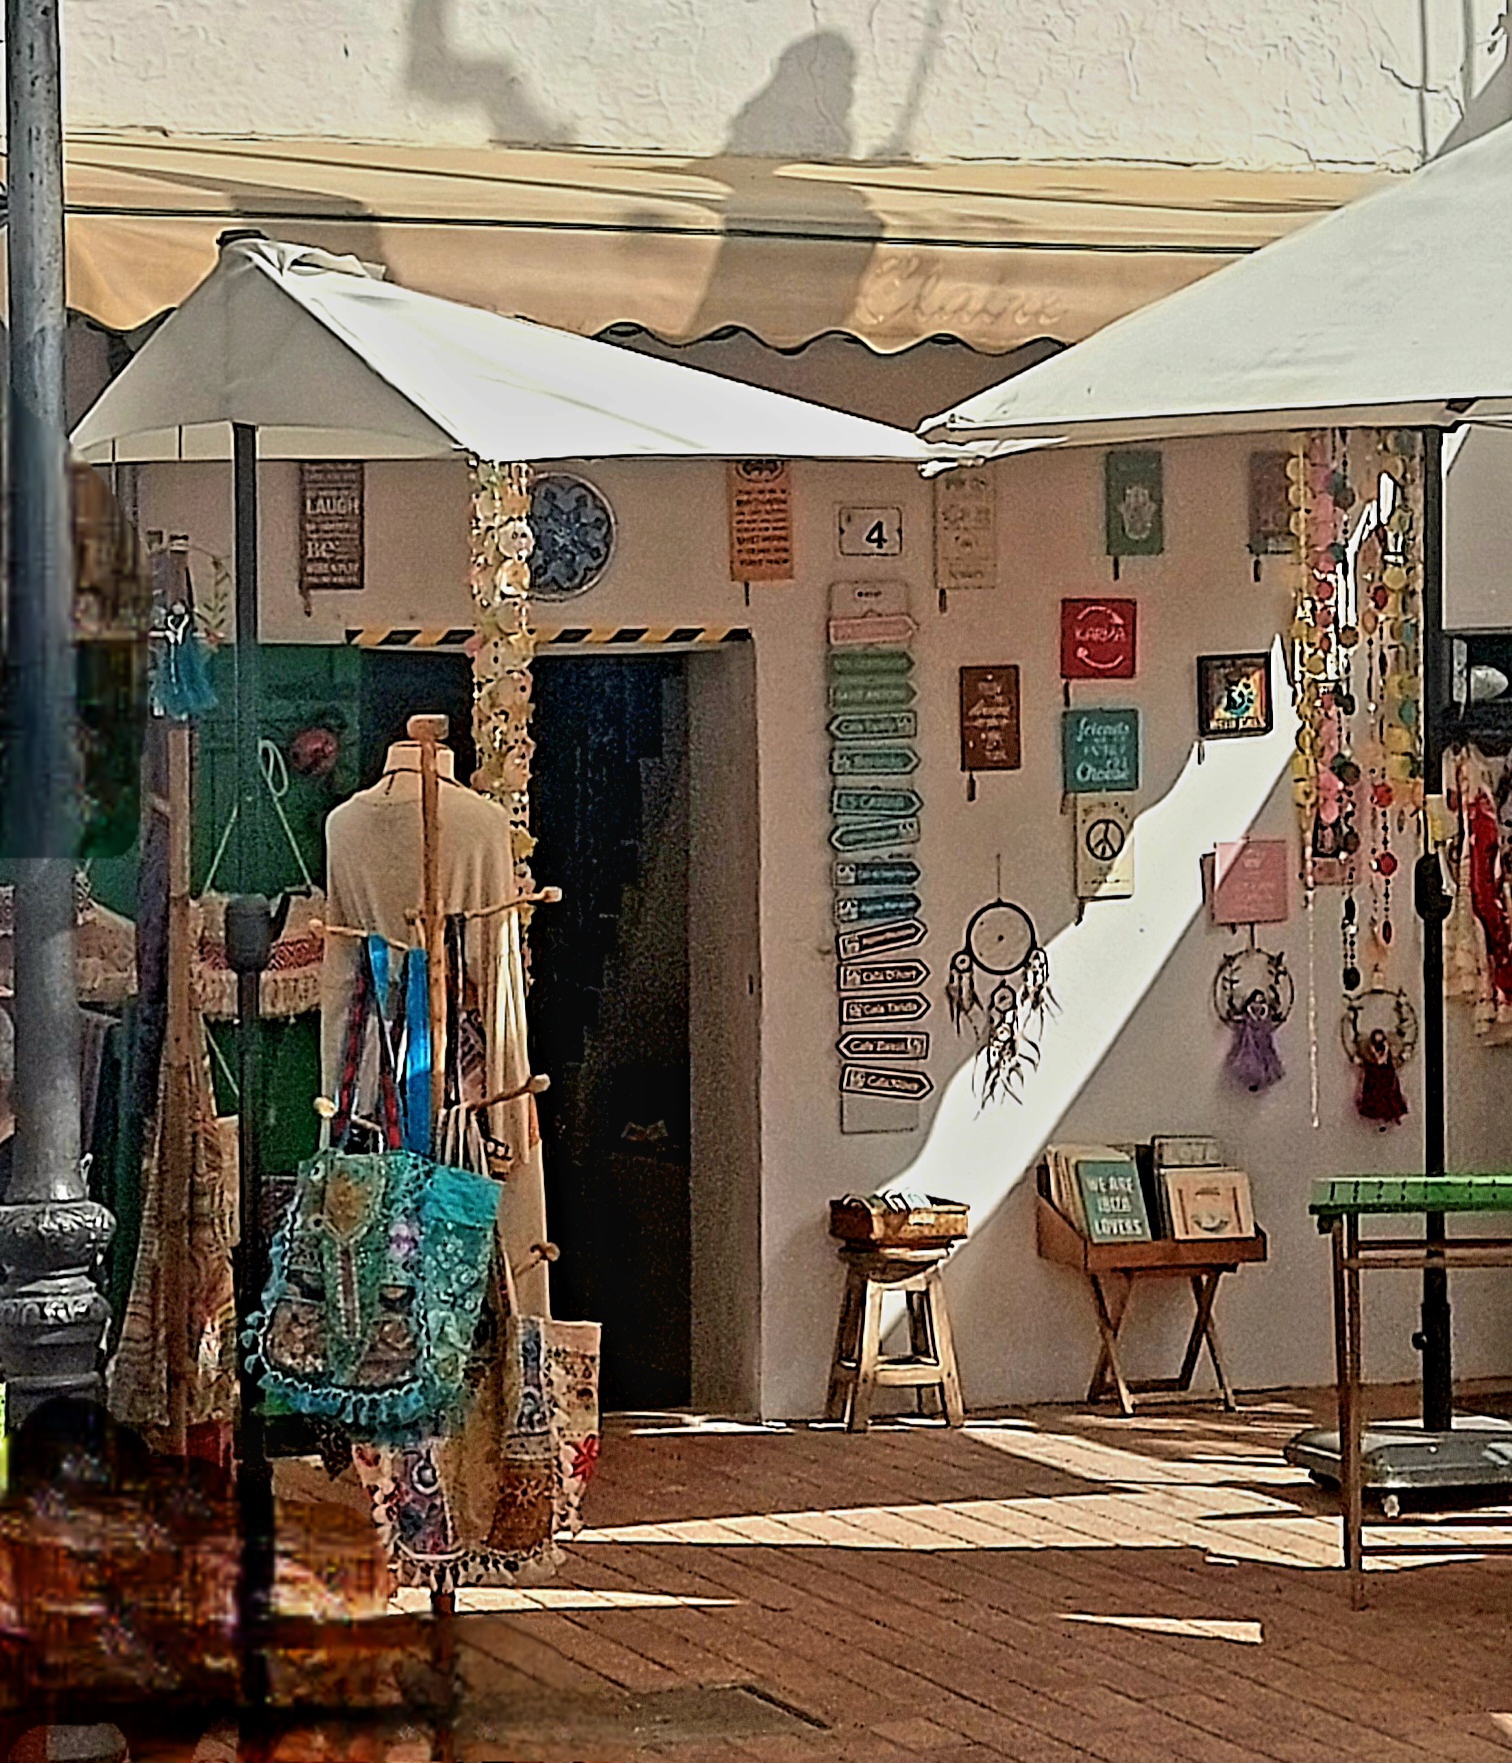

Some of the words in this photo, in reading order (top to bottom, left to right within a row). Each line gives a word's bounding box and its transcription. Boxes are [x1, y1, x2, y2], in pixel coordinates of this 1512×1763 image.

[305, 497, 360, 515] LAUGH
[865, 520, 888, 549] 4
[1093, 1218, 1143, 1236] LOVERS
